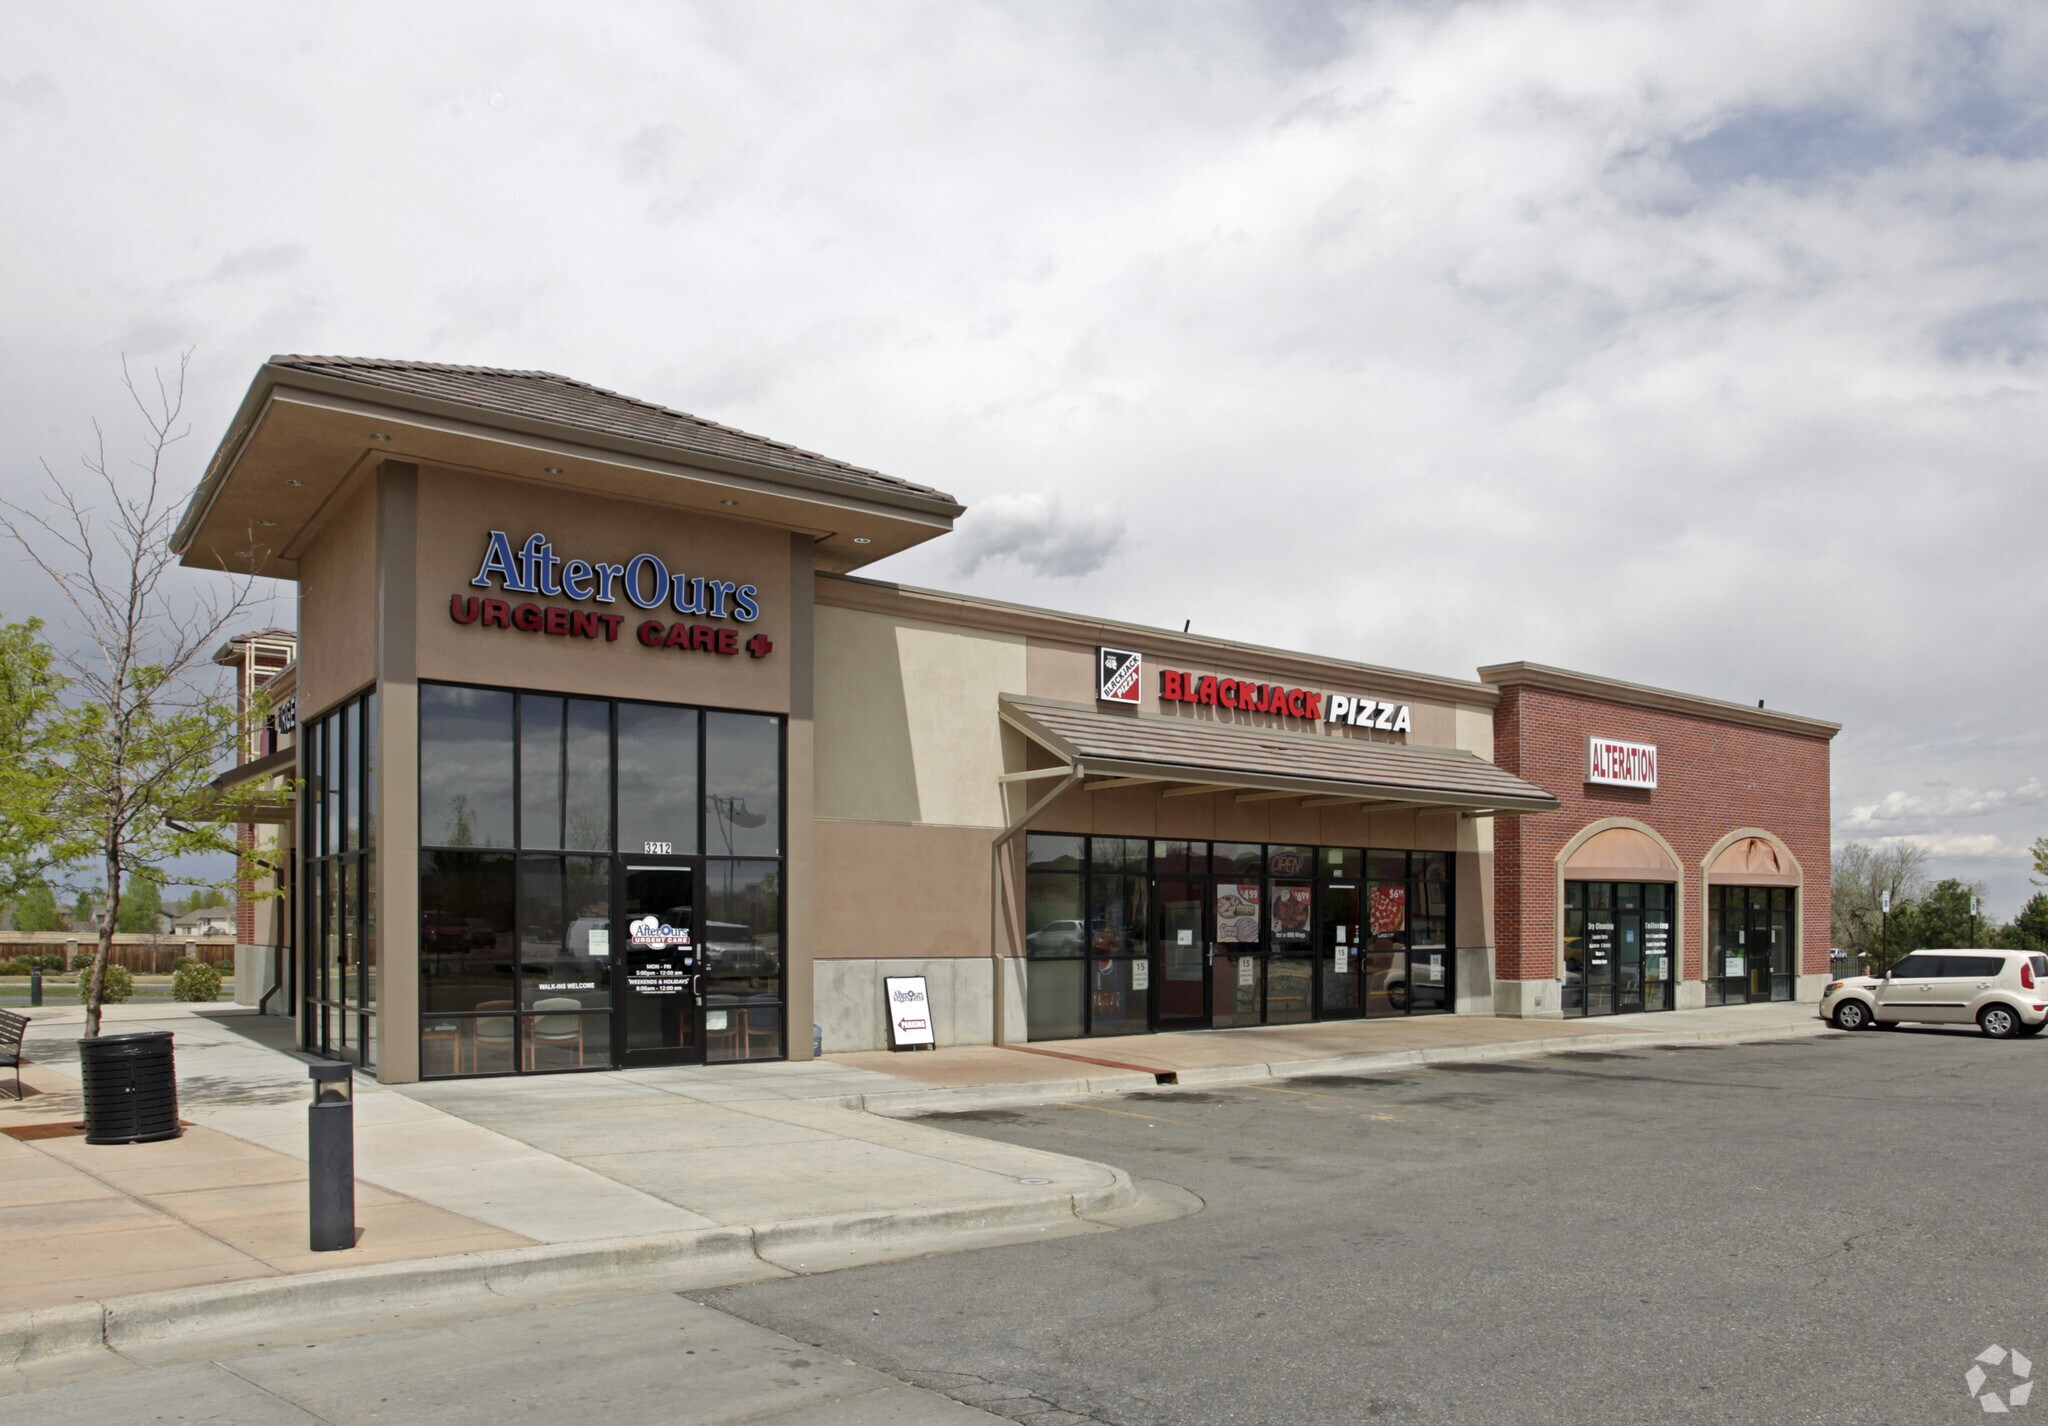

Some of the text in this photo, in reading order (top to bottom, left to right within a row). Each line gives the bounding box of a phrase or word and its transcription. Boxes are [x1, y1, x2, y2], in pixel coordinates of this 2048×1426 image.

[472, 530, 760, 622] AfterOurs
[450, 594, 740, 655] URGENT CARE
[1104, 655, 1139, 697] BLACKJACK
[1116, 672, 1138, 698] PIZZA
[1159, 670, 1412, 732] BLACKJACK PIZZA
[1592, 743, 1655, 783] ALTERATION
[645, 842, 671, 854] 3212
[1271, 856, 1300, 873] OPEN
[635, 924, 687, 936] AfterOurs
[1338, 949, 1345, 957] 15
[1432, 957, 1439, 965] 15
[1136, 962, 1145, 971] 15
[1242, 959, 1251, 967] 15
